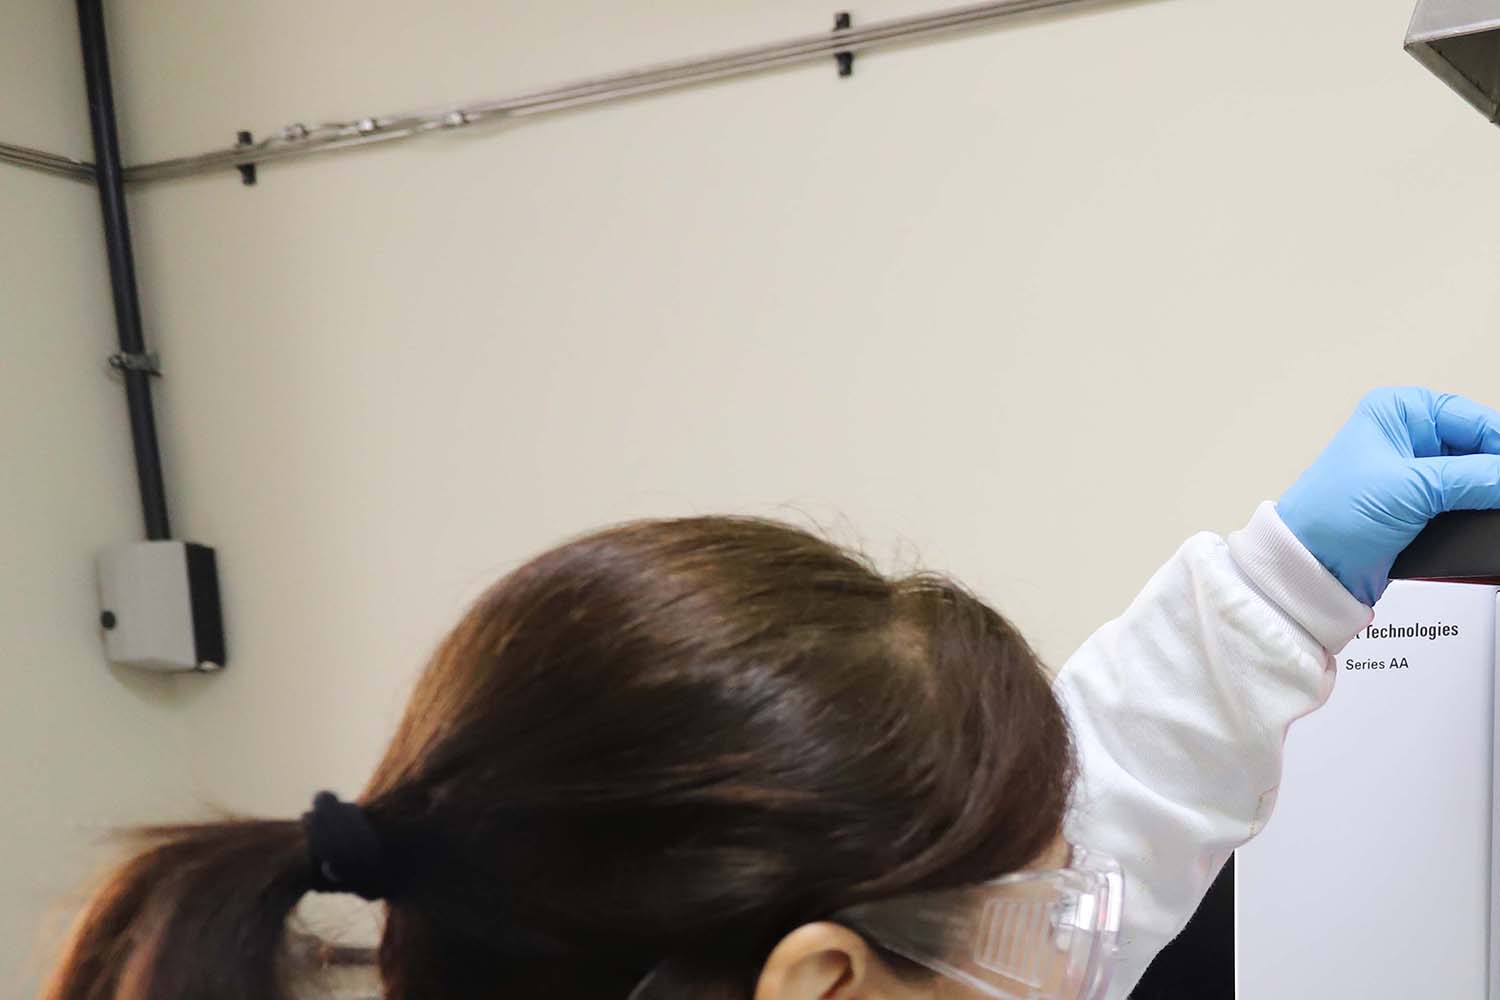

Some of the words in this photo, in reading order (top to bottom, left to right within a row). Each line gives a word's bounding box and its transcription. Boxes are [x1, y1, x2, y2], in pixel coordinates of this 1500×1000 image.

[1366, 622, 1459, 640] Technologies
[1345, 658, 1386, 671] Series
[1390, 658, 1409, 670] AA
